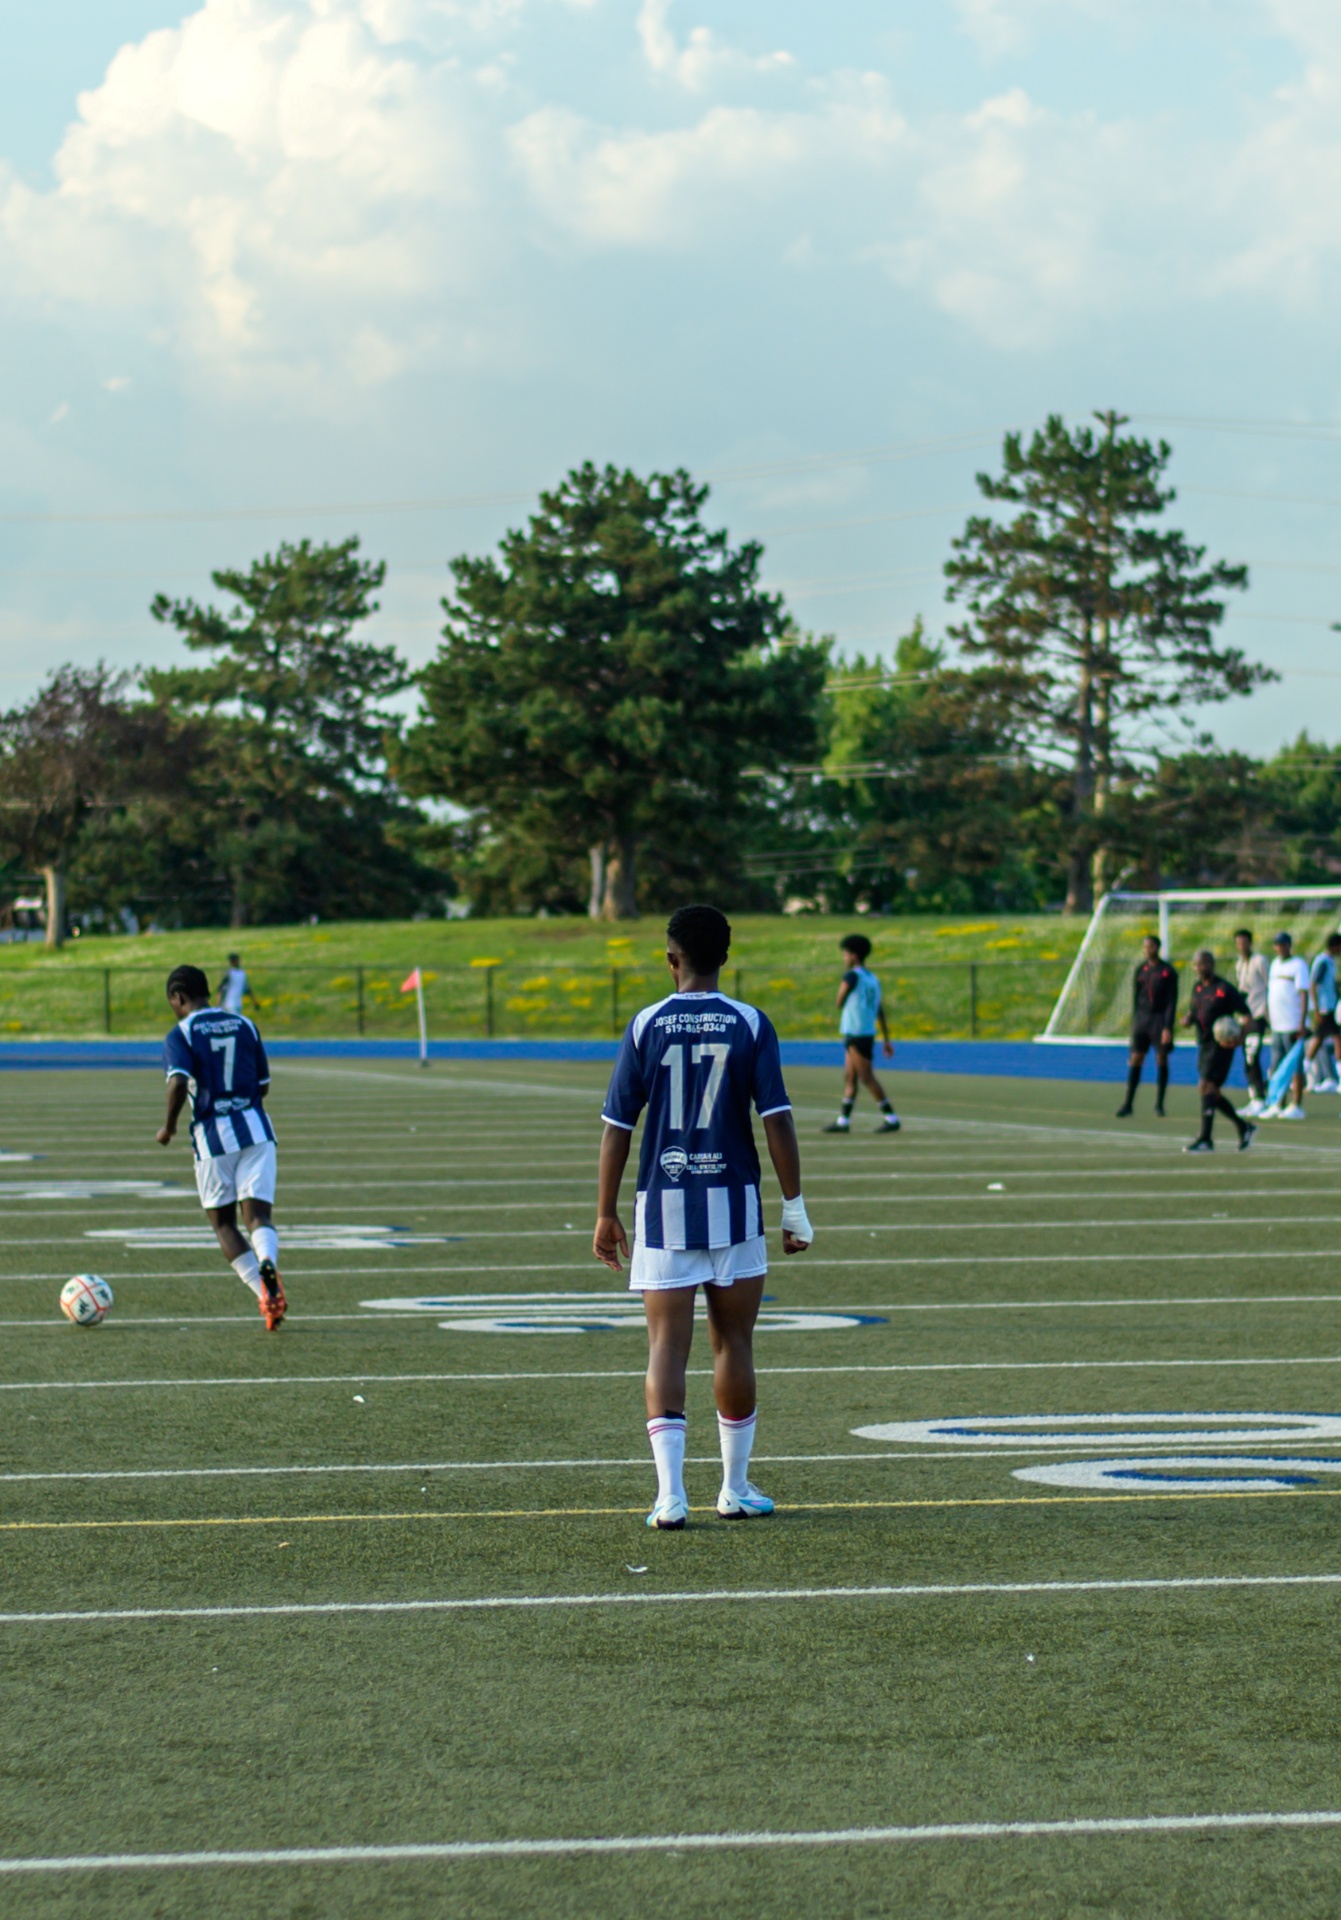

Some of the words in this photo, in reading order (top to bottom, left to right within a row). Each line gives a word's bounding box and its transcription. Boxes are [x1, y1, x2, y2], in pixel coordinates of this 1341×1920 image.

[654, 1014, 677, 1027] JOSEF
[678, 1013, 737, 1024] CONSTRUCTION
[210, 1036, 236, 1091] 7
[661, 1044, 731, 1130] 17
